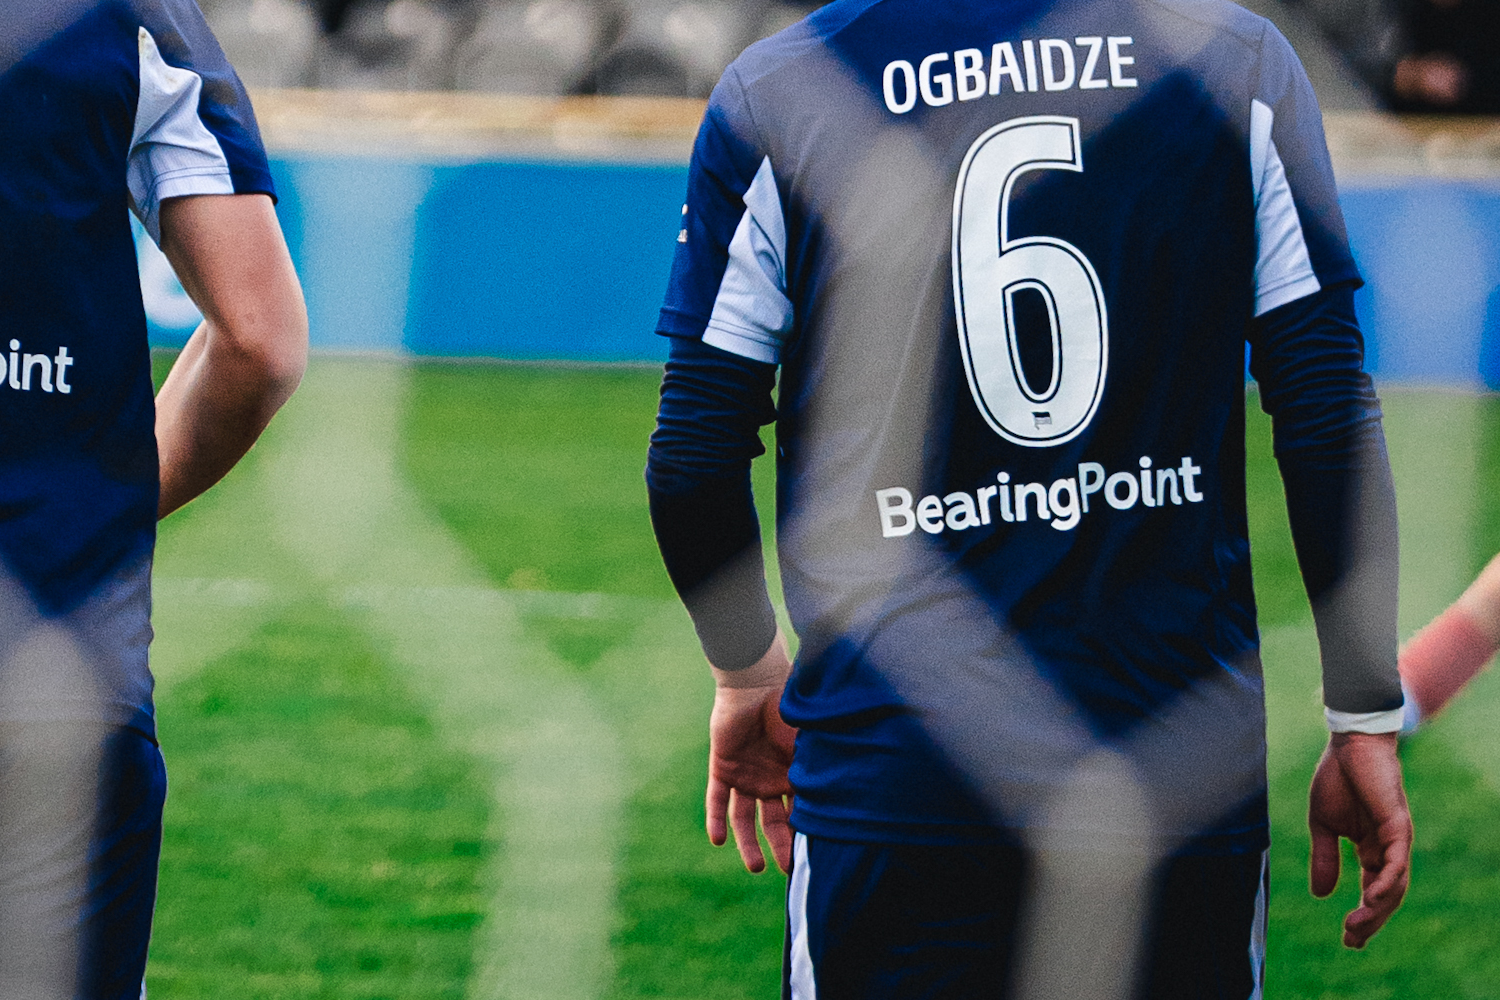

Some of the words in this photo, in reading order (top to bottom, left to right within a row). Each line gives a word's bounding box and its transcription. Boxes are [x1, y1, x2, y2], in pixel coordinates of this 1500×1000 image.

[883, 36, 1138, 115] OGBAIDZE
[951, 115, 1108, 447] 6
[876, 456, 1204, 539] BearingPoint
